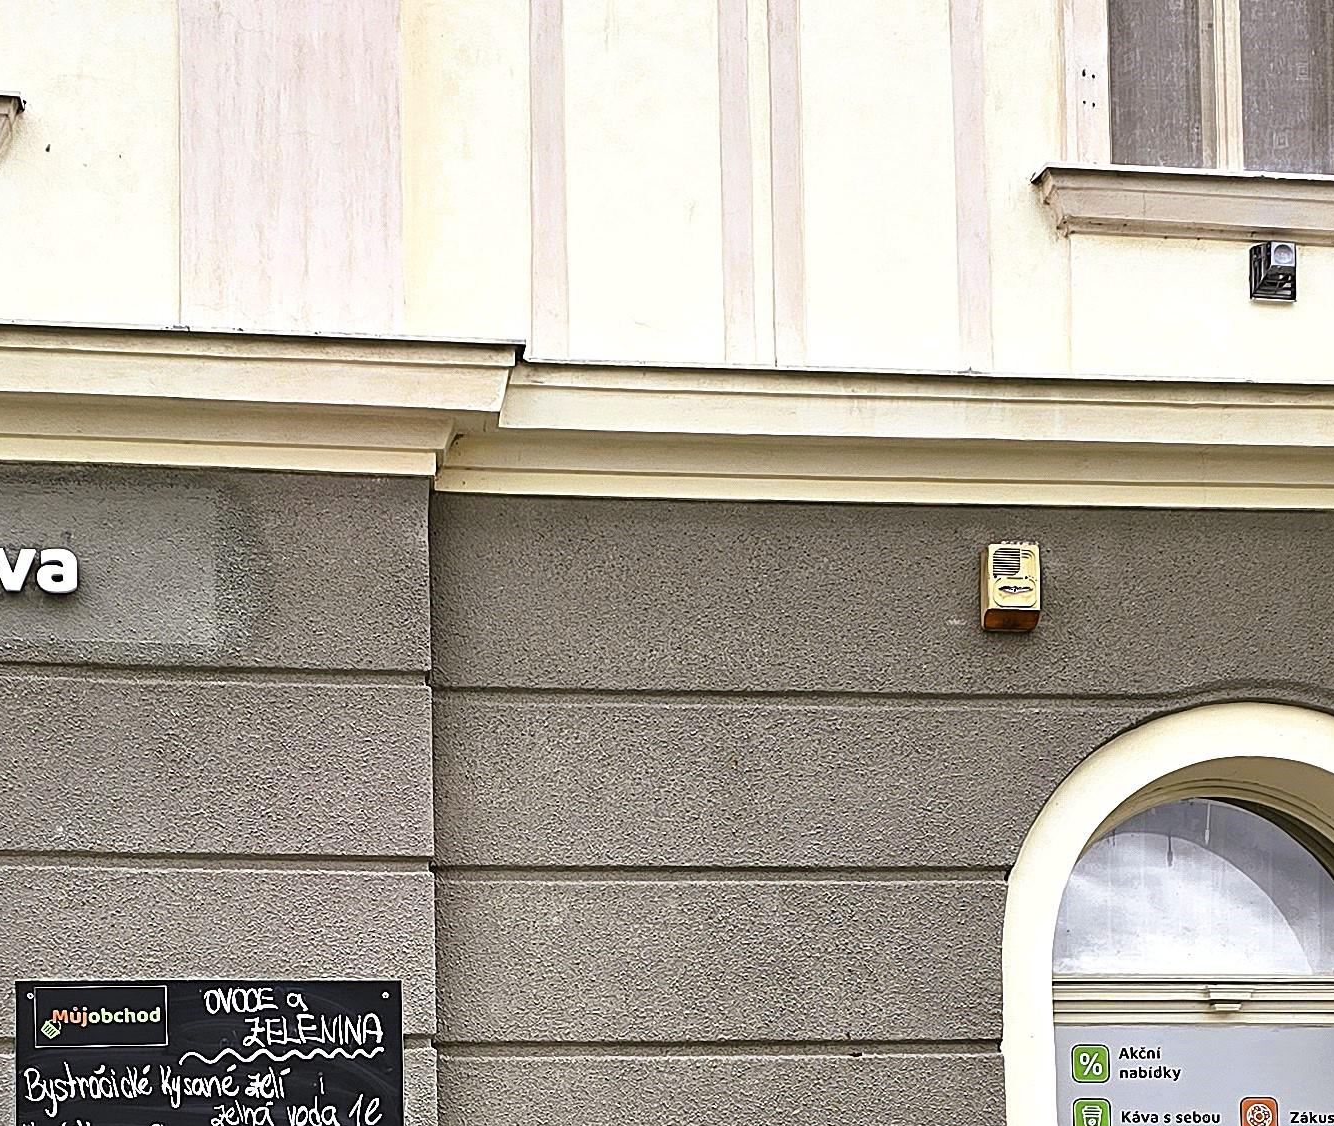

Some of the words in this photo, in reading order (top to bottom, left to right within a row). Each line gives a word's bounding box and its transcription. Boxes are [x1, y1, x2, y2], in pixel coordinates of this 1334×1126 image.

[204, 988, 278, 1014] OVOCE
[287, 992, 308, 1012] a
[243, 1013, 383, 1047] ZELENINA
[1118, 1047, 1161, 1060] Akční
[245, 1067, 291, 1099] zelí
[1119, 1066, 1181, 1081] nabídky
[211, 1100, 274, 1126] zelná
[1121, 1110, 1159, 1124] Káva
[1163, 1114, 1171, 1124] s
[1175, 1111, 1221, 1124] sebou
